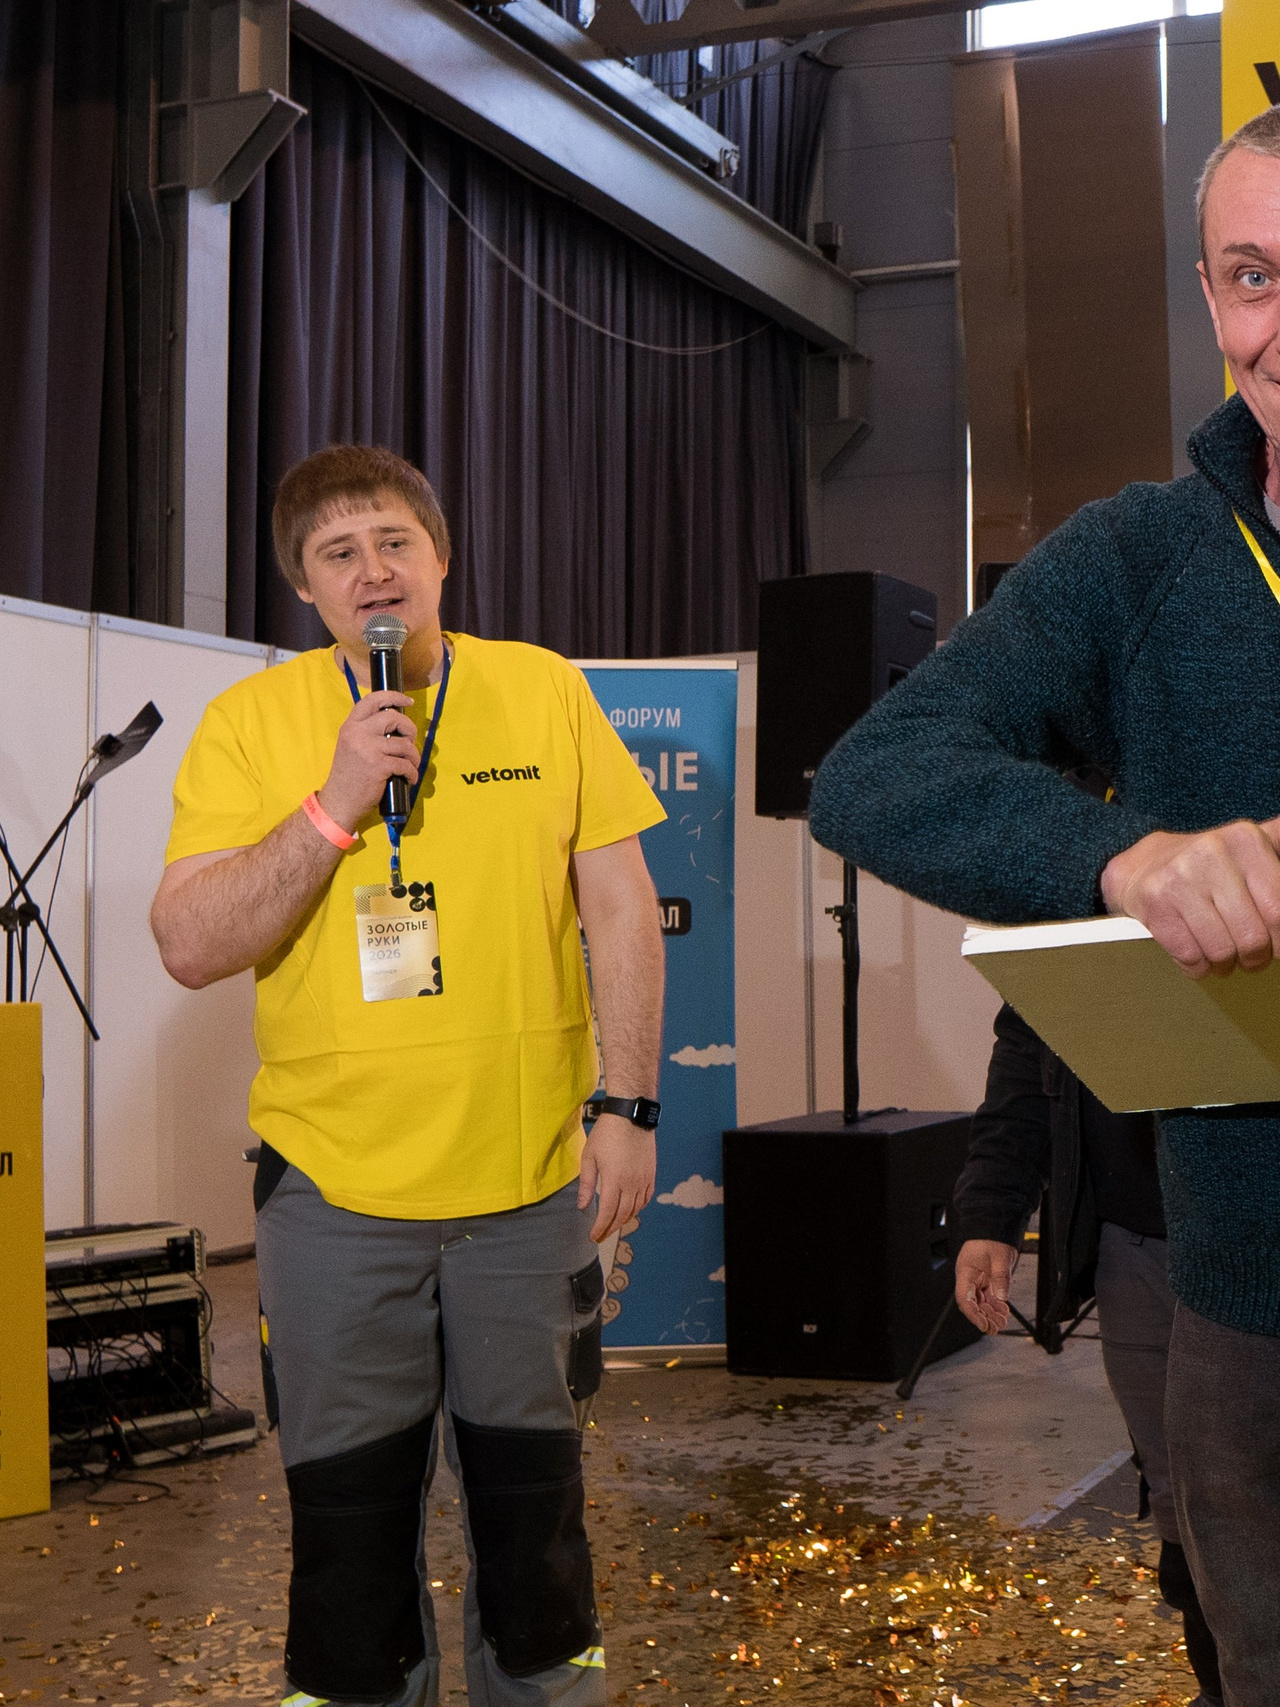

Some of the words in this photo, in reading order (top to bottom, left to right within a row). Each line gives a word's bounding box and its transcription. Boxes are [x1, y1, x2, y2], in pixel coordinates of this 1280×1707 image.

[609, 707, 681, 728] ФОРУМ
[461, 765, 541, 785] vetonit
[367, 920, 429, 935] ЗОЛОТЫЕ
[367, 935, 400, 948] РУКИ
[369, 949, 401, 961] 2026
